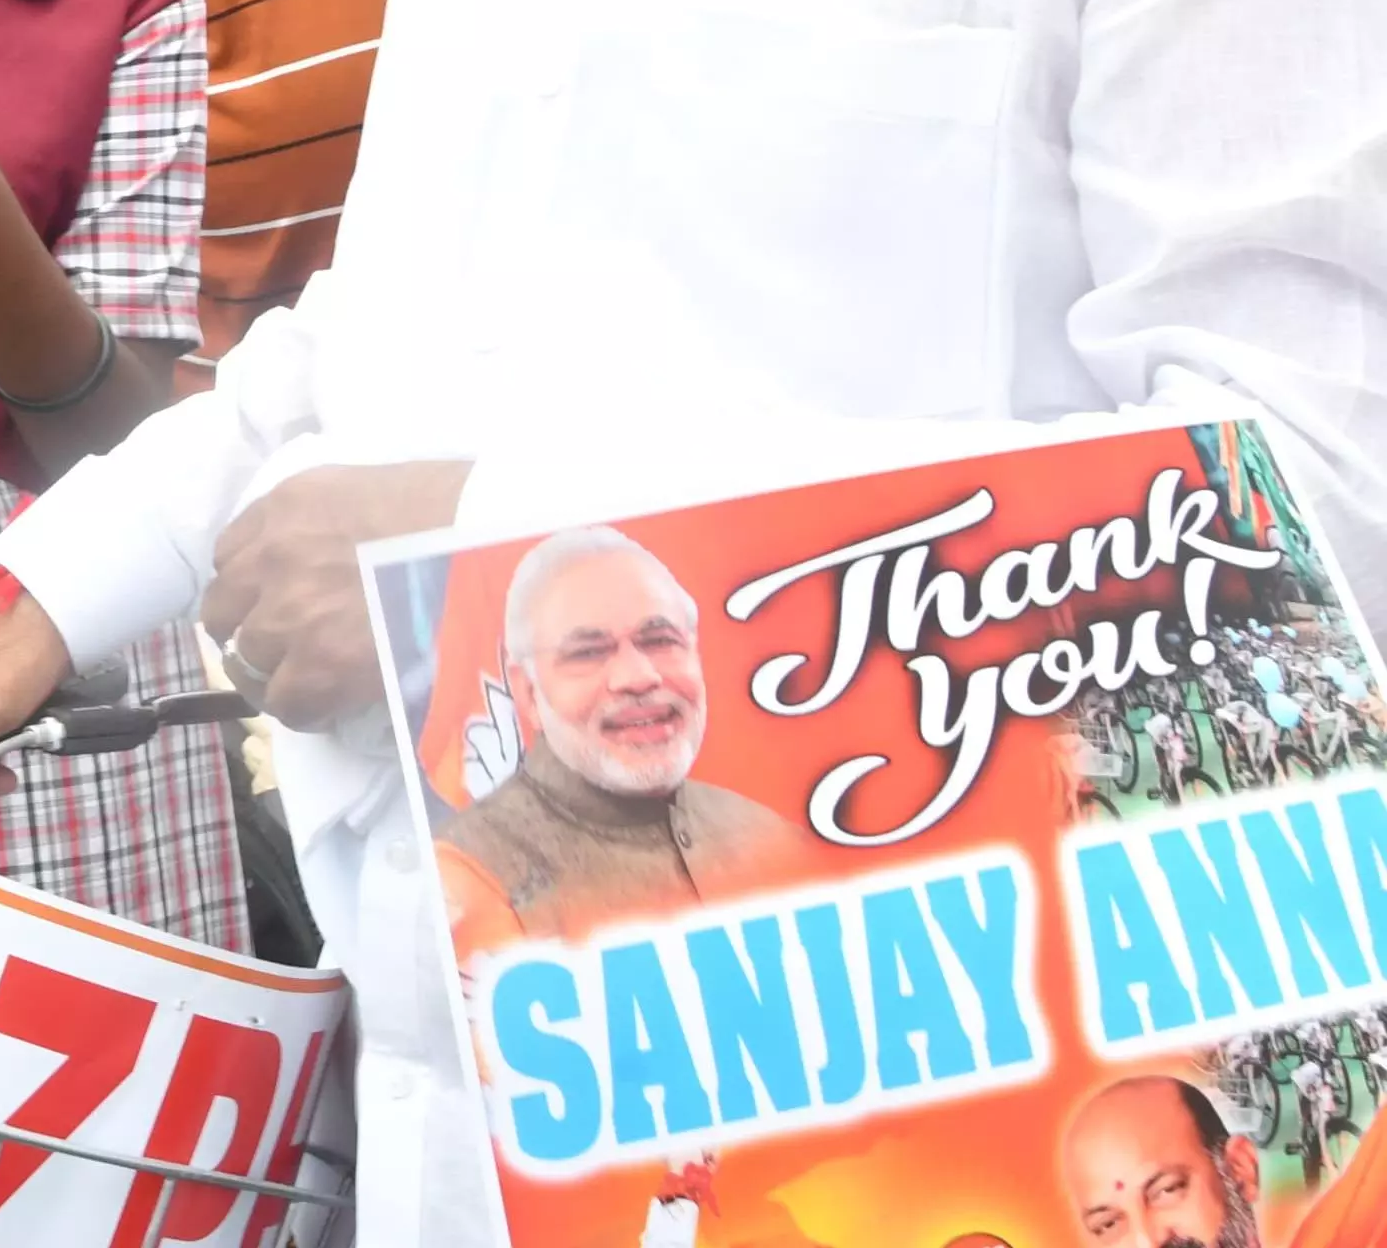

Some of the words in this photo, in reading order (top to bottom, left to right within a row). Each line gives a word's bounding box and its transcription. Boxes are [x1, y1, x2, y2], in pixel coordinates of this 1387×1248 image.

[724, 468, 1282, 717] Thank
[809, 557, 1220, 847] you!
[492, 865, 1034, 1162] SANJAY
